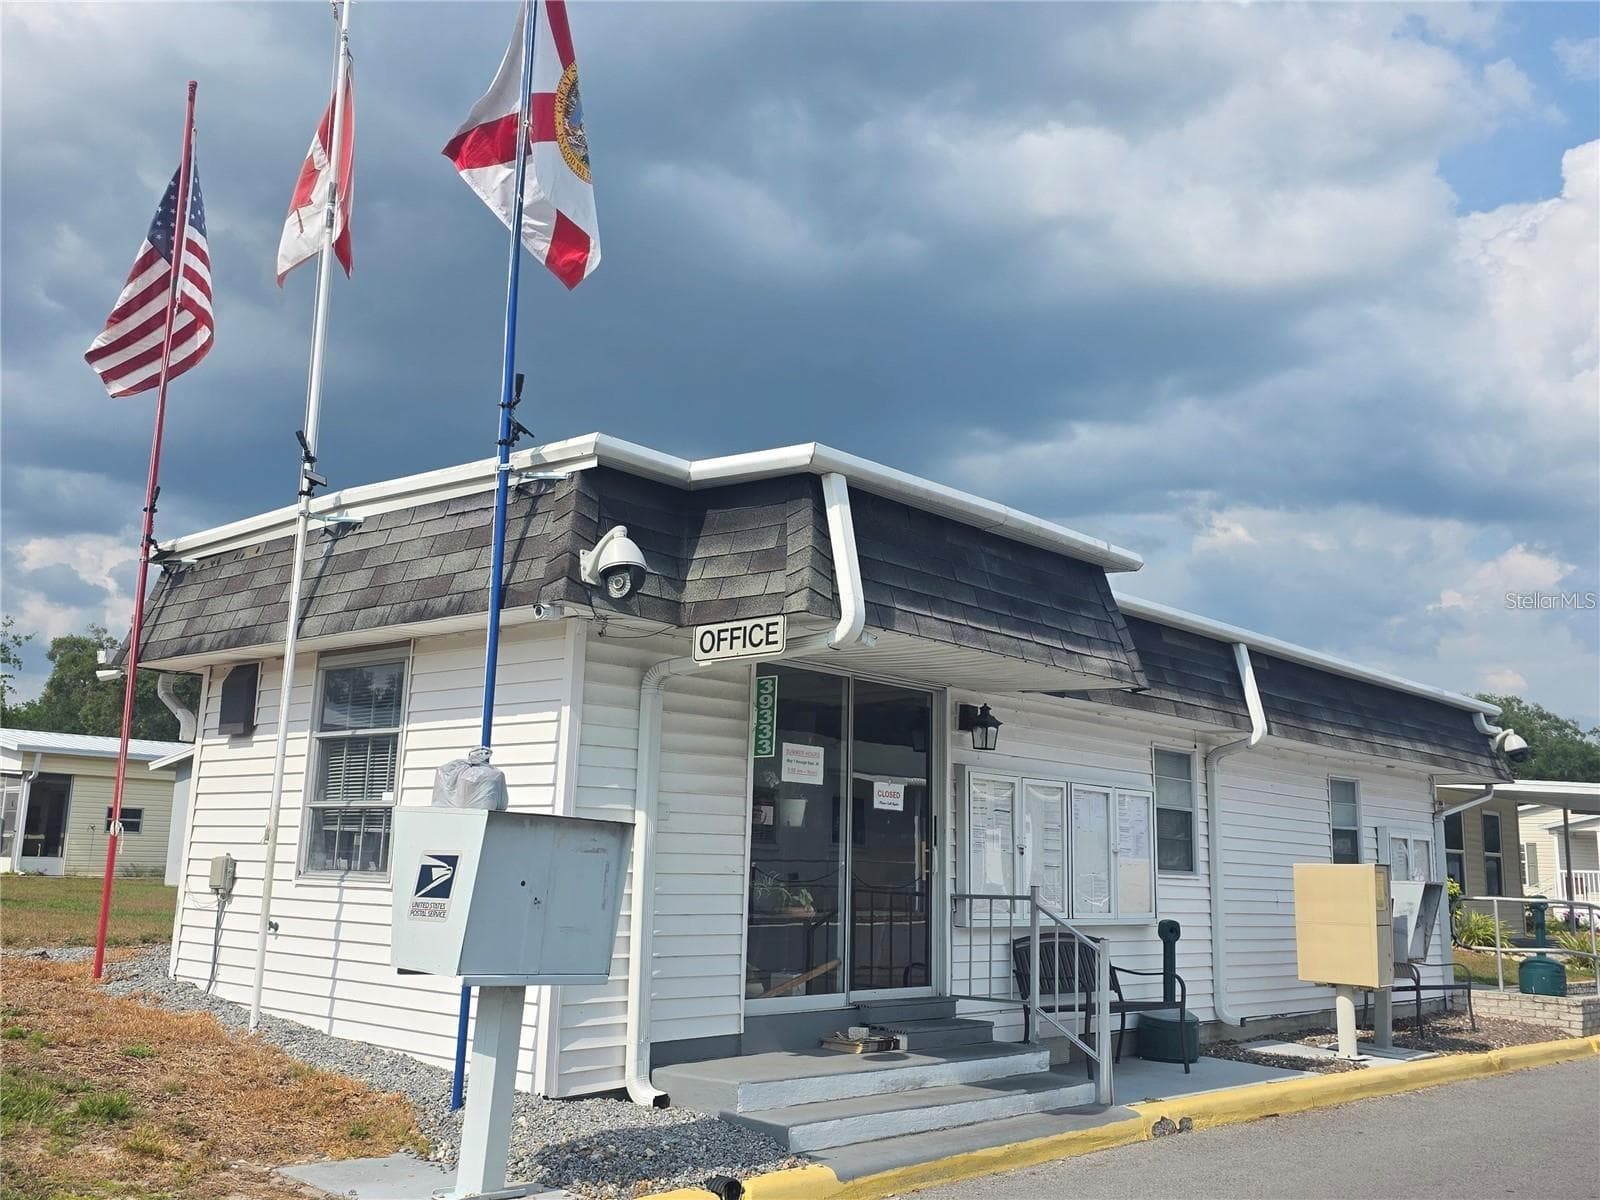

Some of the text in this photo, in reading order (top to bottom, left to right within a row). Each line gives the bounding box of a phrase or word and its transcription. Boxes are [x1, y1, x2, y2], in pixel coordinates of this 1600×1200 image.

[699, 621, 779, 653] OFFICE
[756, 679, 774, 755] 39333
[877, 790, 901, 799] CLOSED
[429, 902, 446, 910] STATES
[409, 909, 447, 918] POSTAL SERVICE
